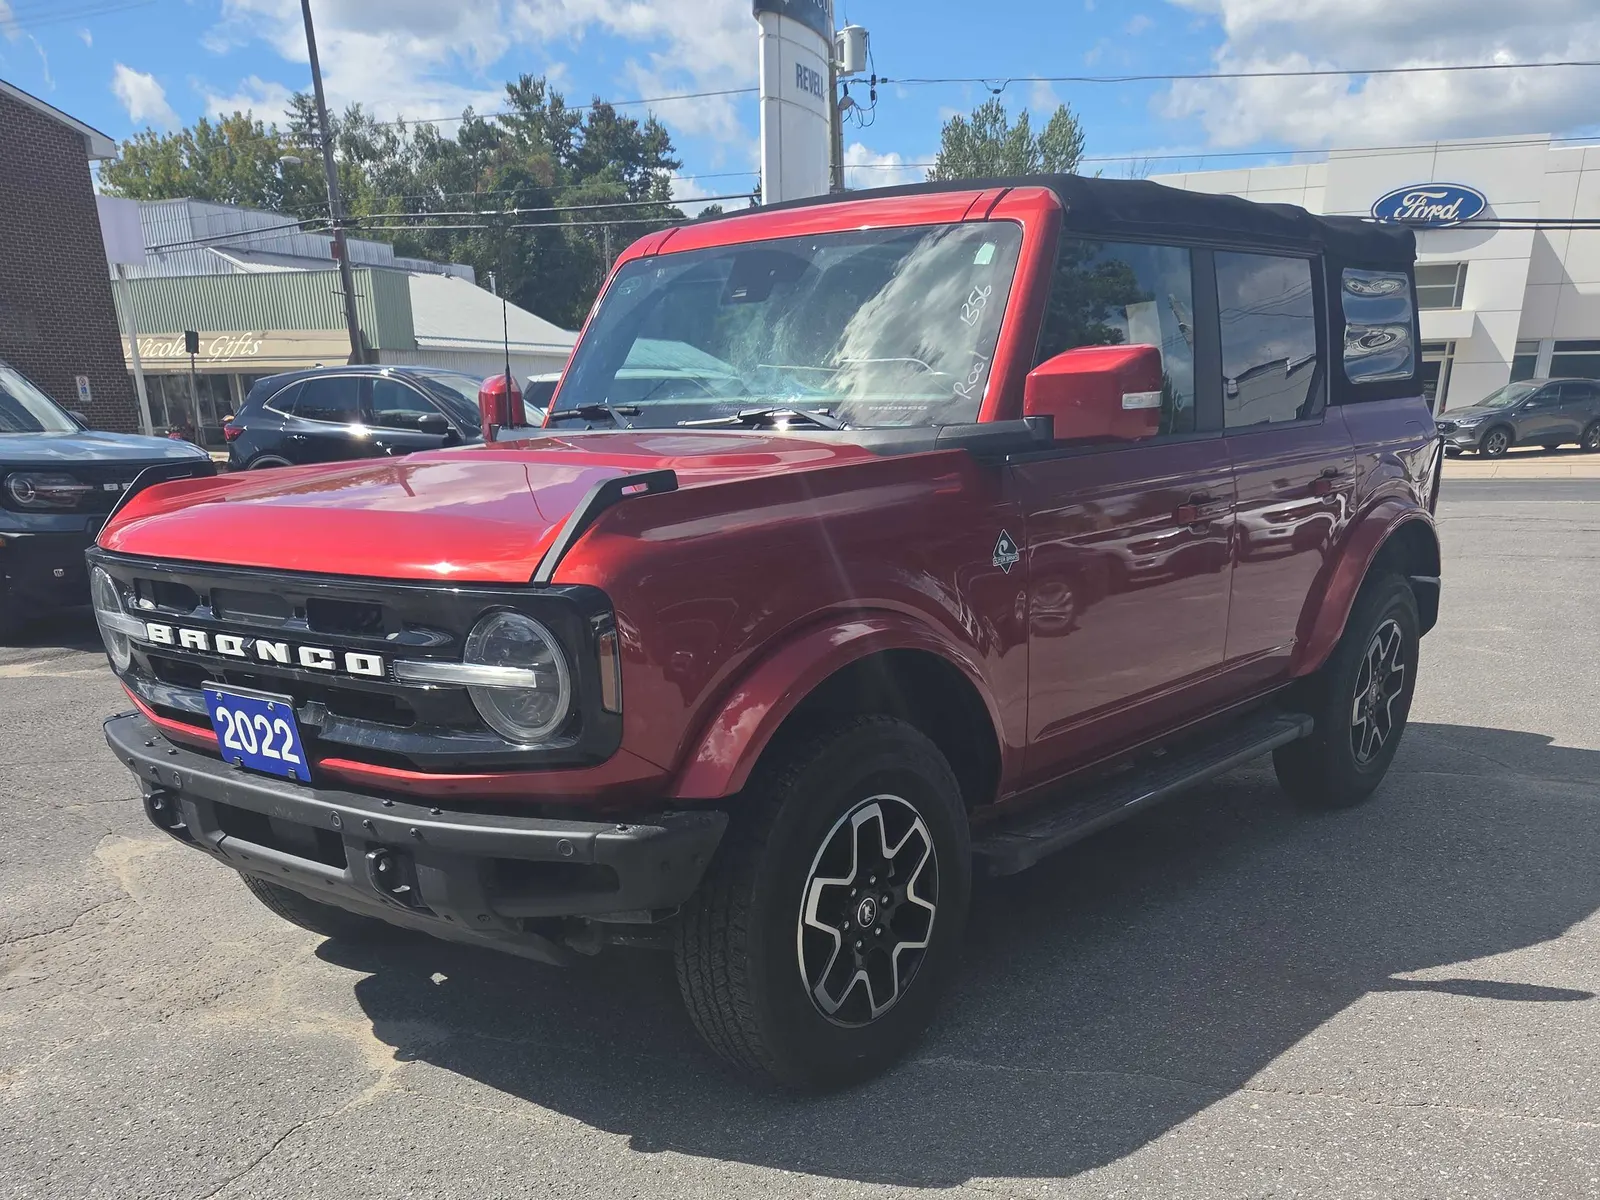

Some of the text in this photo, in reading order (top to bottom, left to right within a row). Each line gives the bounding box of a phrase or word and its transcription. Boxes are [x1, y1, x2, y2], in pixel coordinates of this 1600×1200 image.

[1393, 192, 1464, 221] Ford
[206, 332, 262, 362] Gifts
[146, 622, 385, 677] BRONCO
[215, 706, 301, 764] 2022
